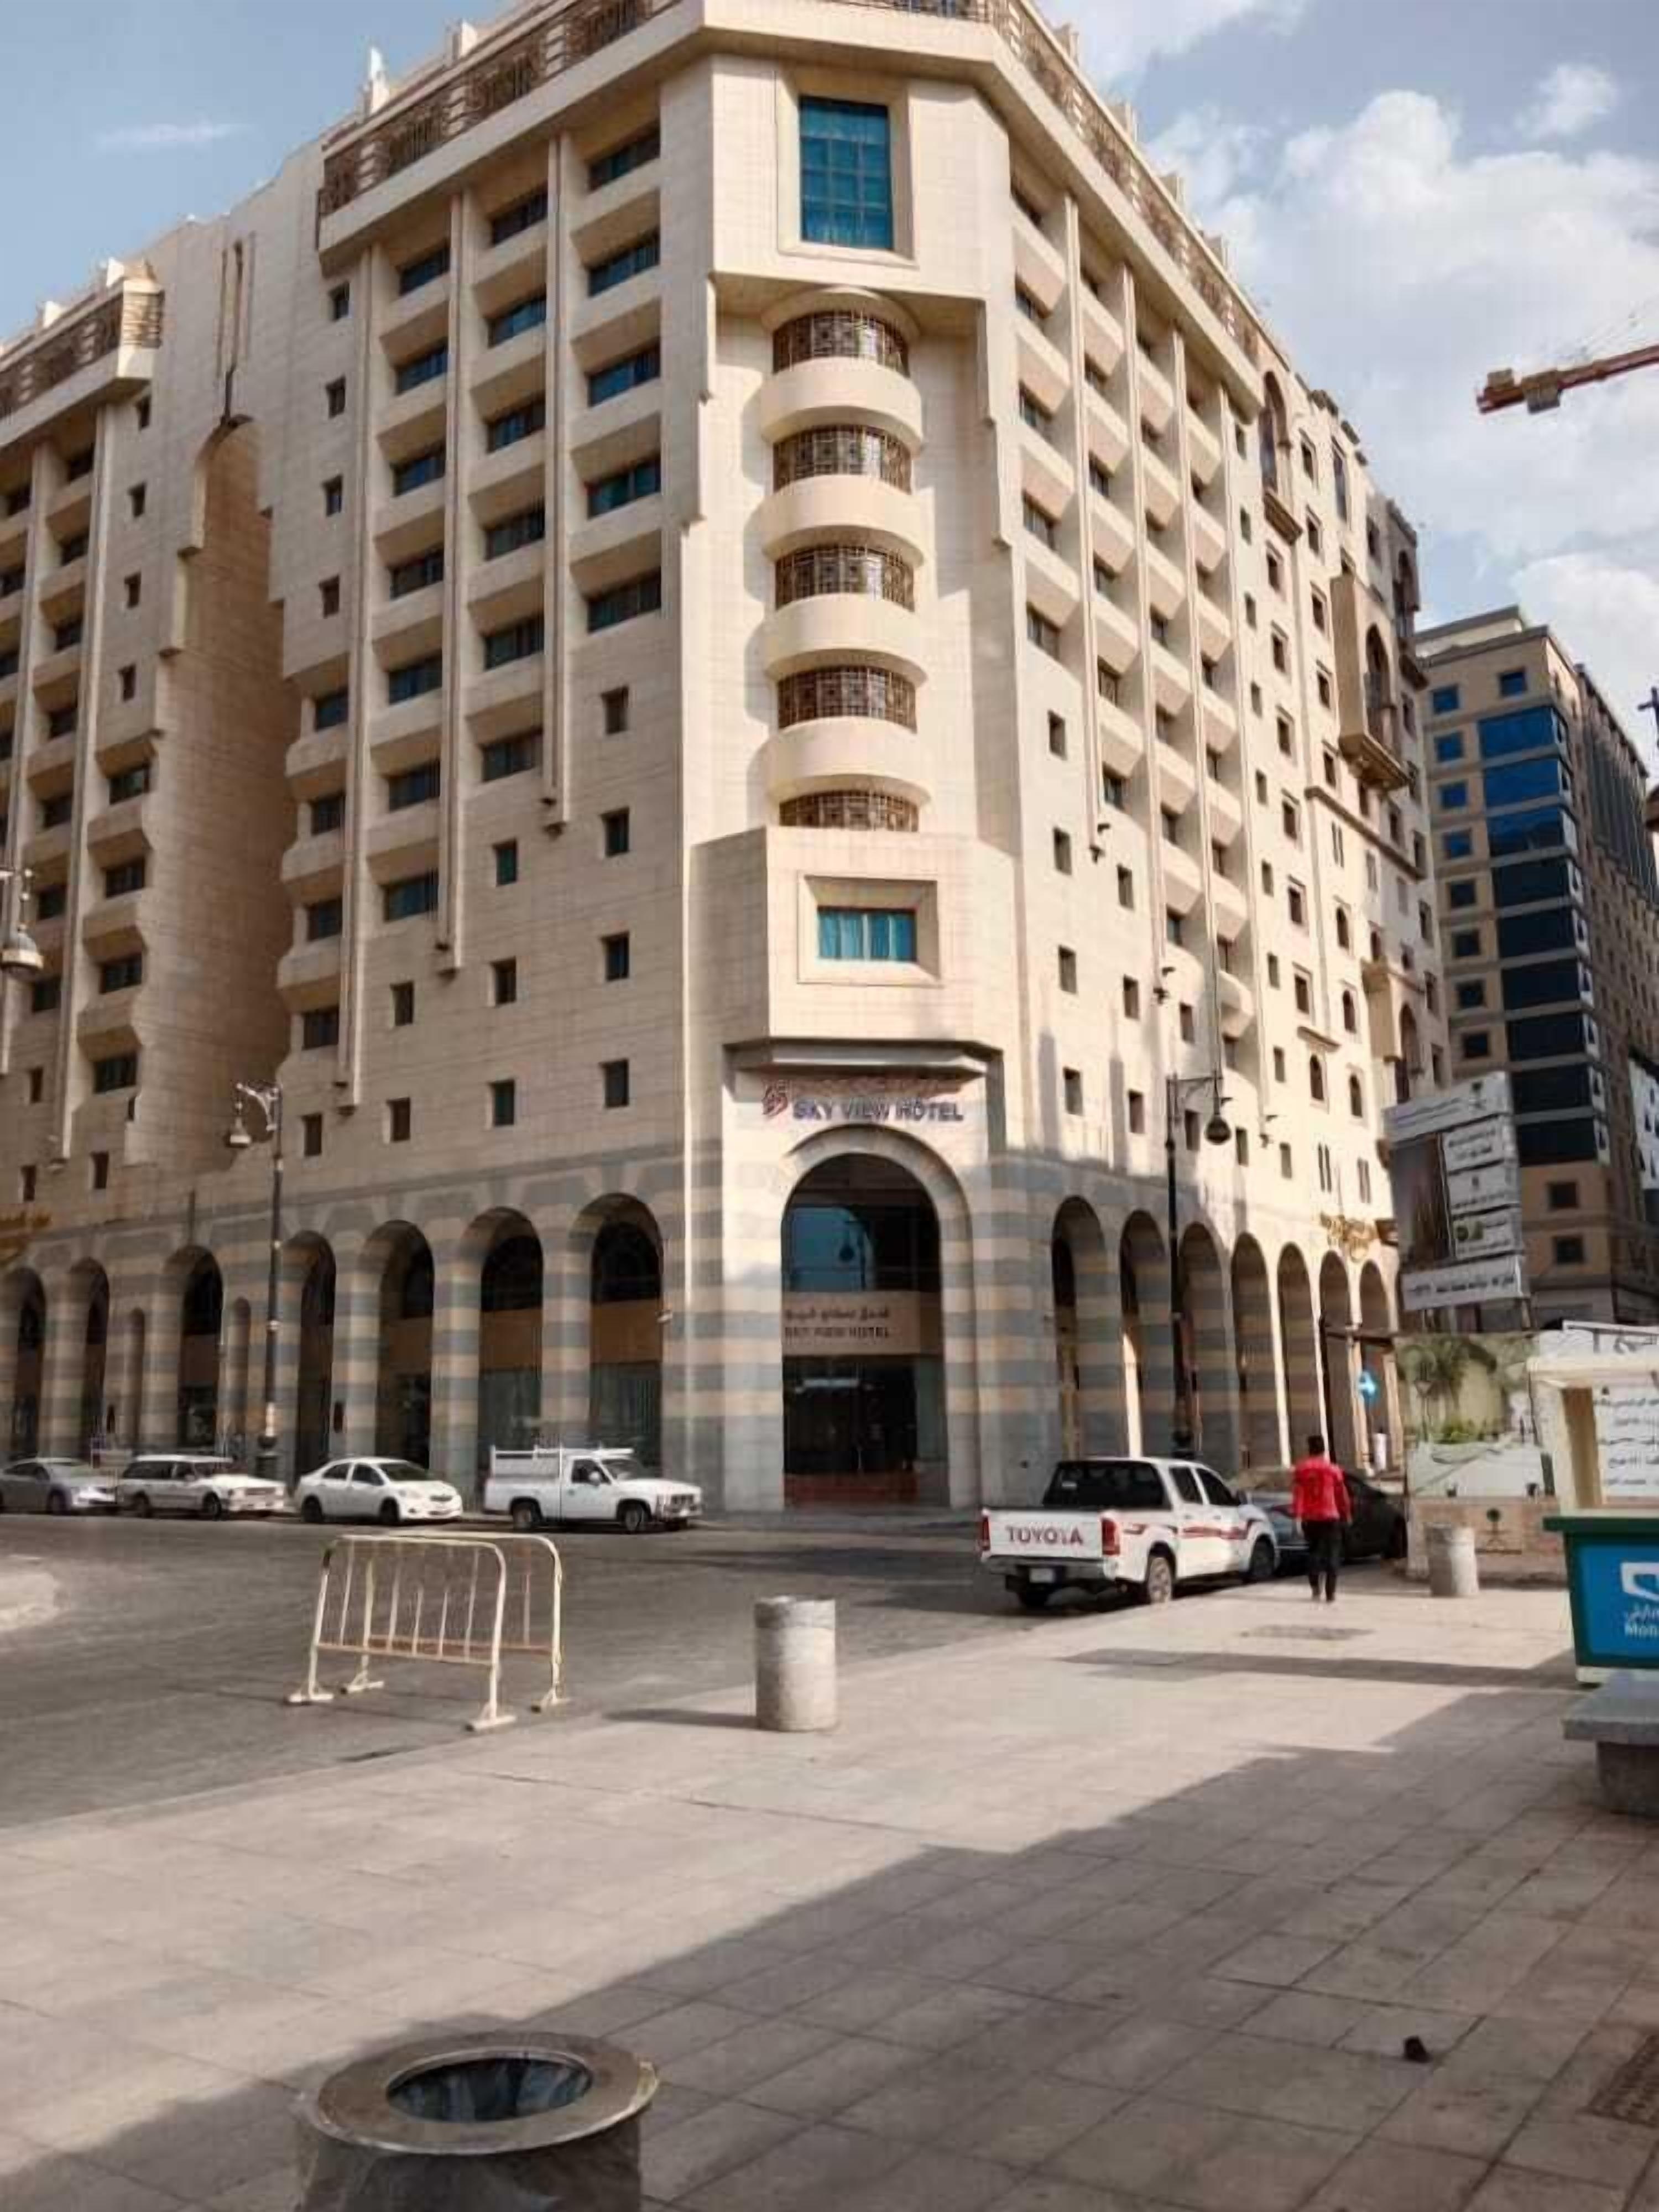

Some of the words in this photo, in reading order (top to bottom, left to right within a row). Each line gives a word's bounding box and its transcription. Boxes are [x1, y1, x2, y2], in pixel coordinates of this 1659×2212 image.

[793, 1097, 832, 1120] SKY
[846, 1097, 890, 1120] VIEW
[895, 1098, 964, 1121] HOTEL
[1005, 1525, 1083, 1546] TOYOTA
